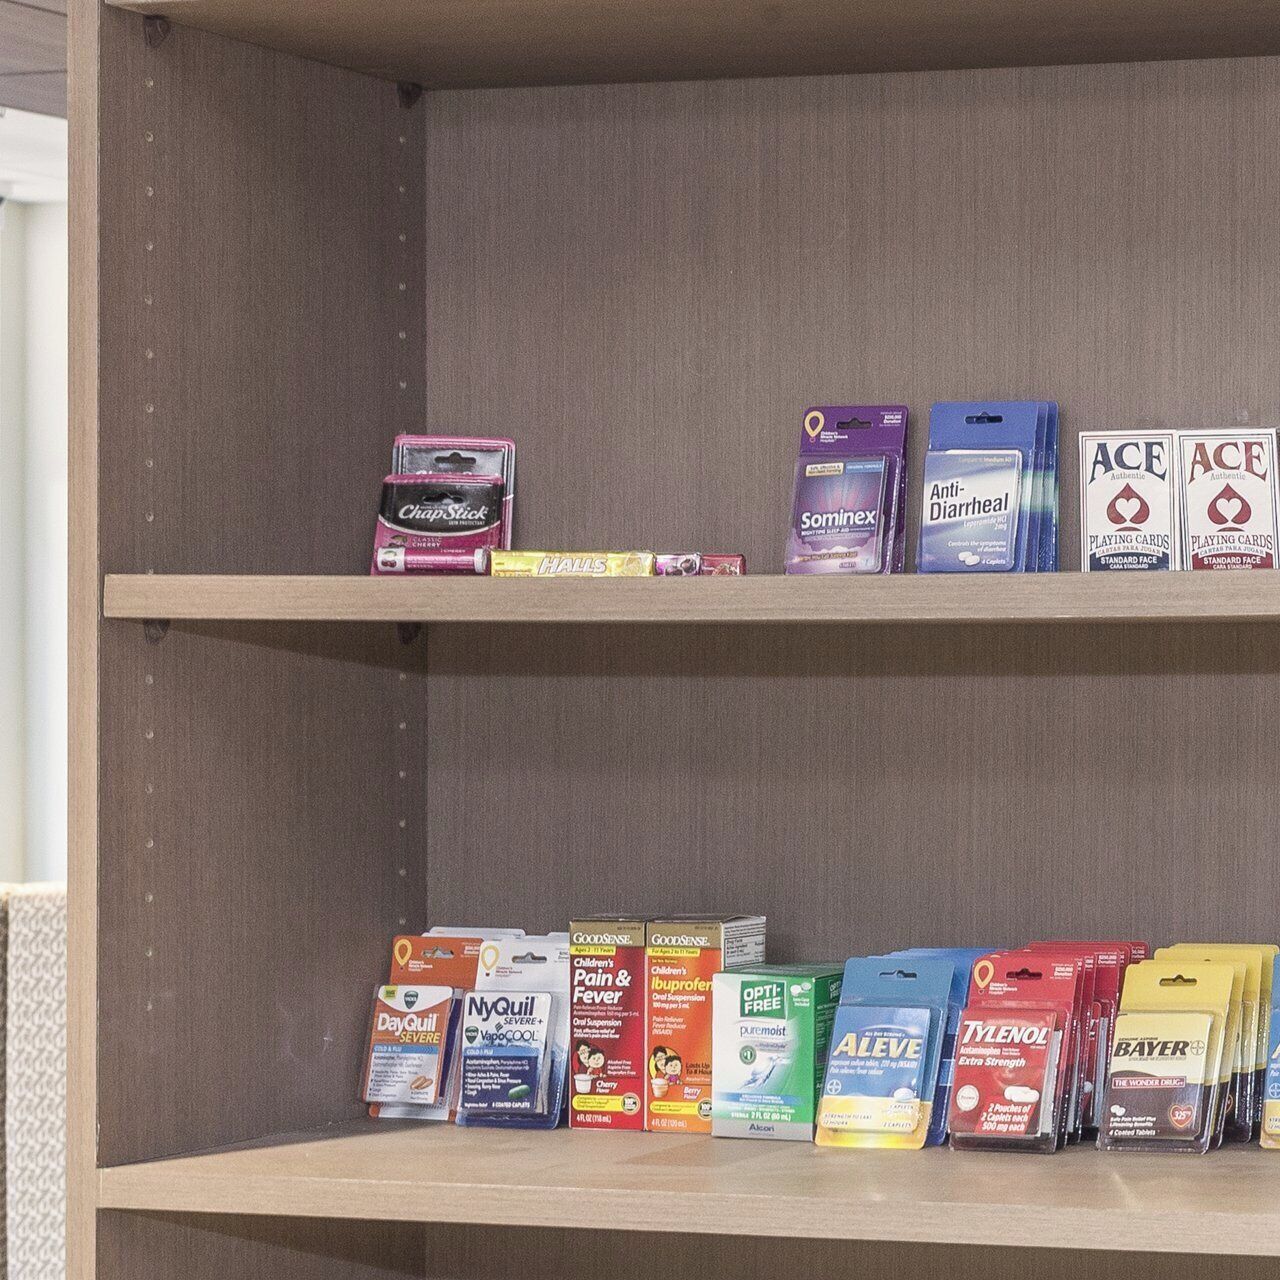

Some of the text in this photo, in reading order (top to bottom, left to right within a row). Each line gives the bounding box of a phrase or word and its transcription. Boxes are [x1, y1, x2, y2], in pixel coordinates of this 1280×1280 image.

[1088, 442, 1167, 485] ACE
[1188, 442, 1268, 485] ACE
[1110, 472, 1146, 481] Authentic
[930, 481, 964, 500] Anti-
[398, 504, 489, 522] ChapStick
[930, 493, 1009, 521] Diarrheal
[801, 509, 877, 529] Sominex
[1089, 535, 1170, 551] PLAYING CARDS
[539, 557, 607, 575] HALLS
[1101, 556, 1157, 564] STANDARD FACE
[1204, 556, 1261, 565] STANDARD FACE
[574, 958, 614, 968] Children's
[651, 966, 687, 976] Children's
[573, 969, 632, 987] Pain &
[651, 976, 712, 996] Ibuprofen
[573, 988, 623, 1004] Fever
[666, 994, 706, 1002] Suspension
[743, 985, 781, 1000] OPTI-
[468, 996, 535, 1022] NyQuil
[744, 999, 781, 1014] FREE
[377, 1013, 438, 1036] DayQuil
[573, 1018, 622, 1028] Oral Suspension
[399, 1031, 441, 1044] SEVERE
[480, 1030, 538, 1046] VapoCOOL
[740, 1026, 786, 1042] puremoist
[961, 1020, 1050, 1045] TYLENOL
[832, 1033, 923, 1058] ALEVE
[1113, 1040, 1187, 1057] BAYER
[958, 1057, 1026, 1068] Extra Strength
[596, 1080, 617, 1090] Cherry
